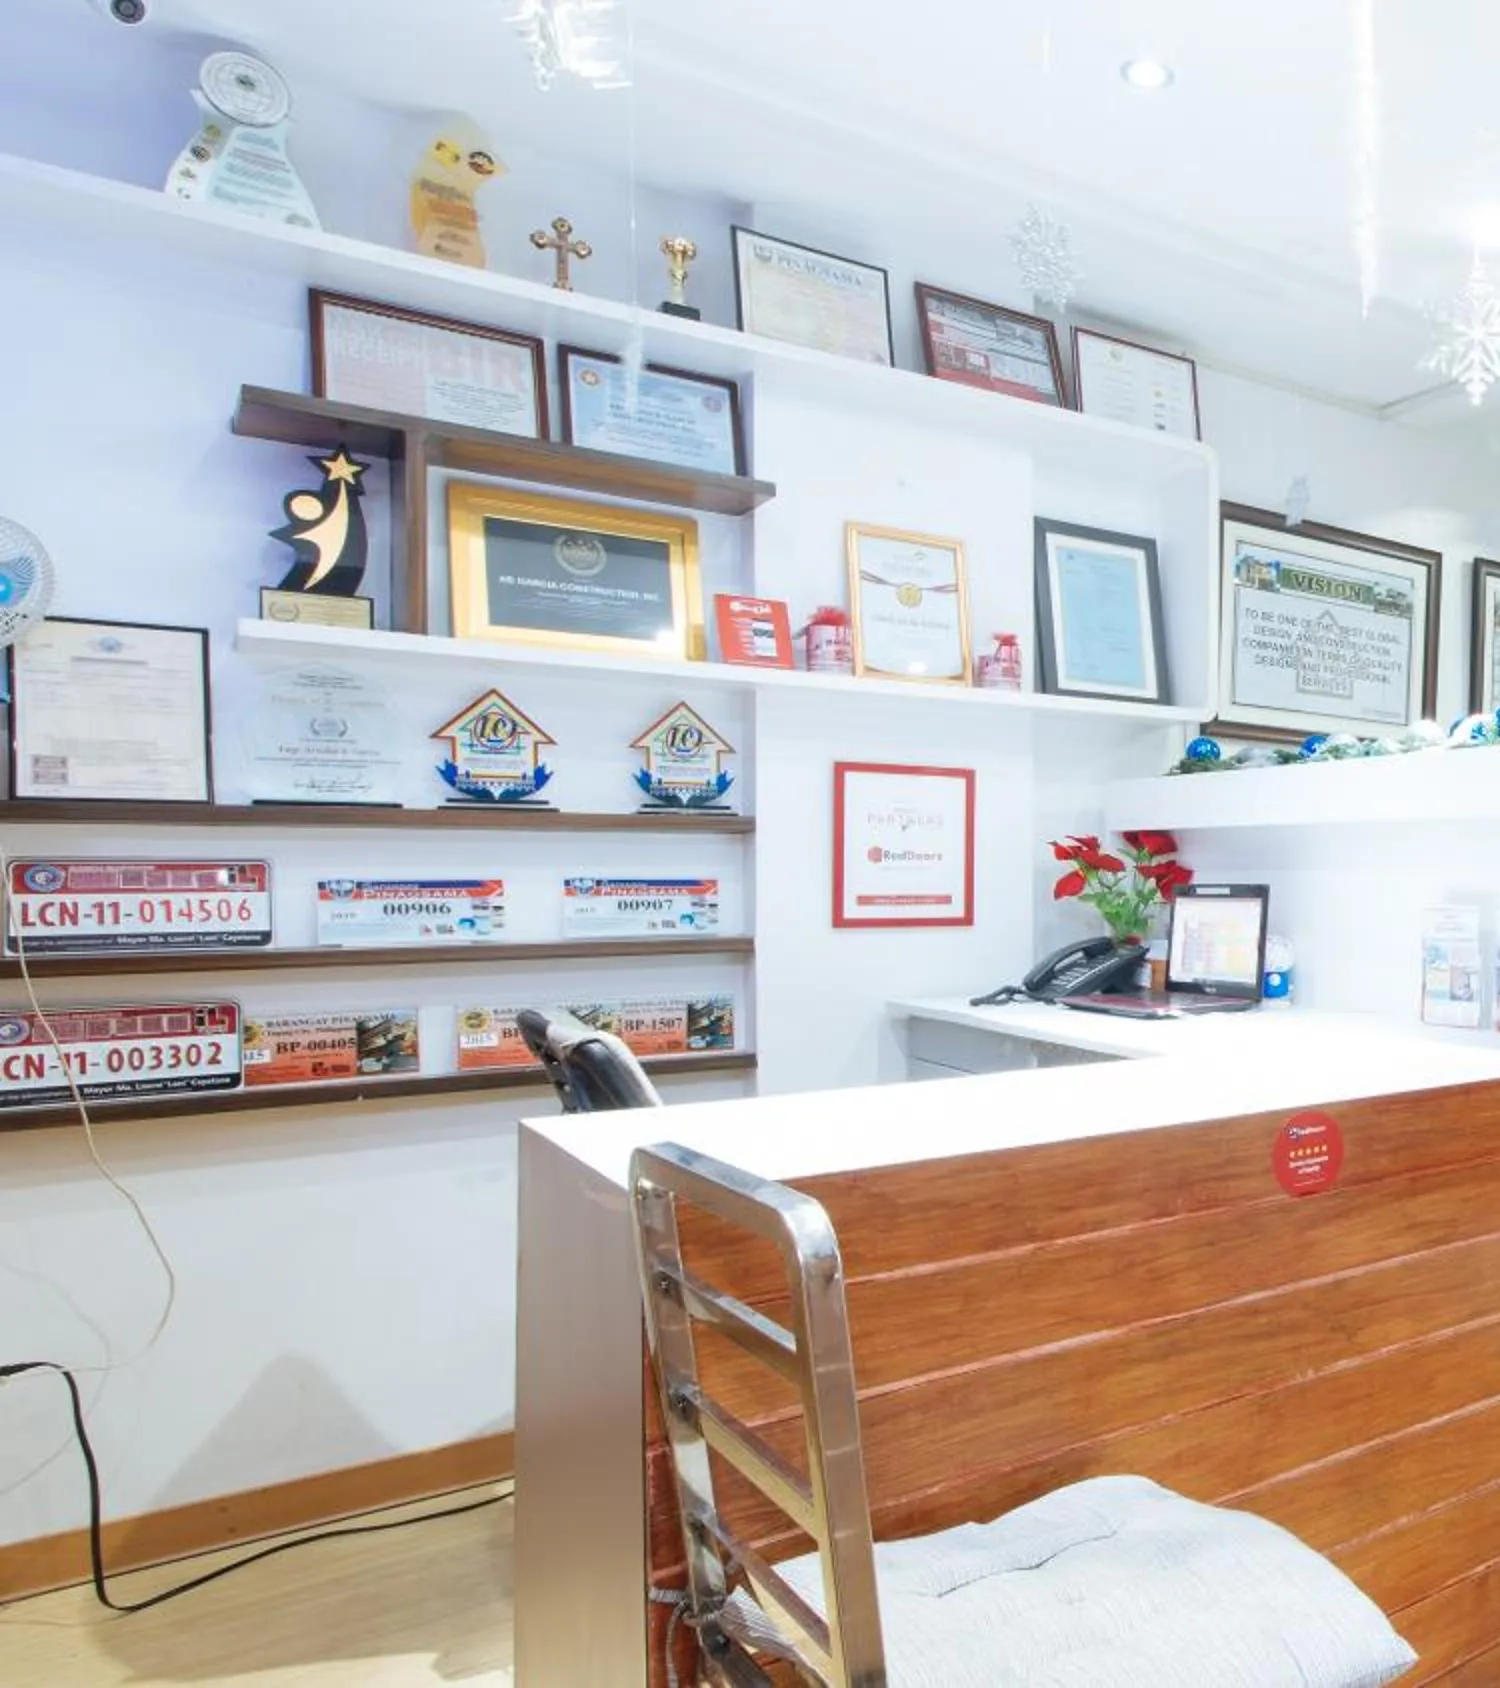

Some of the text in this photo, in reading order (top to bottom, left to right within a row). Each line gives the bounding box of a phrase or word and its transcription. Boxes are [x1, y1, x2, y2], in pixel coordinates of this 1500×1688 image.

[1292, 572, 1362, 600] VISION
[1245, 608, 1259, 619] TO
[1261, 610, 1275, 623] BE
[1277, 613, 1297, 626] ONE
[1300, 617, 1313, 629] OF
[1365, 629, 1402, 644] GLOBAL
[1252, 625, 1292, 641] DESIGN
[21, 897, 253, 928] LCN-11-014506
[383, 902, 452, 916] 00906
[617, 899, 674, 912] 00907
[276, 1037, 356, 1055] BP-00405
[0, 1041, 222, 1081] CN-11-003302
